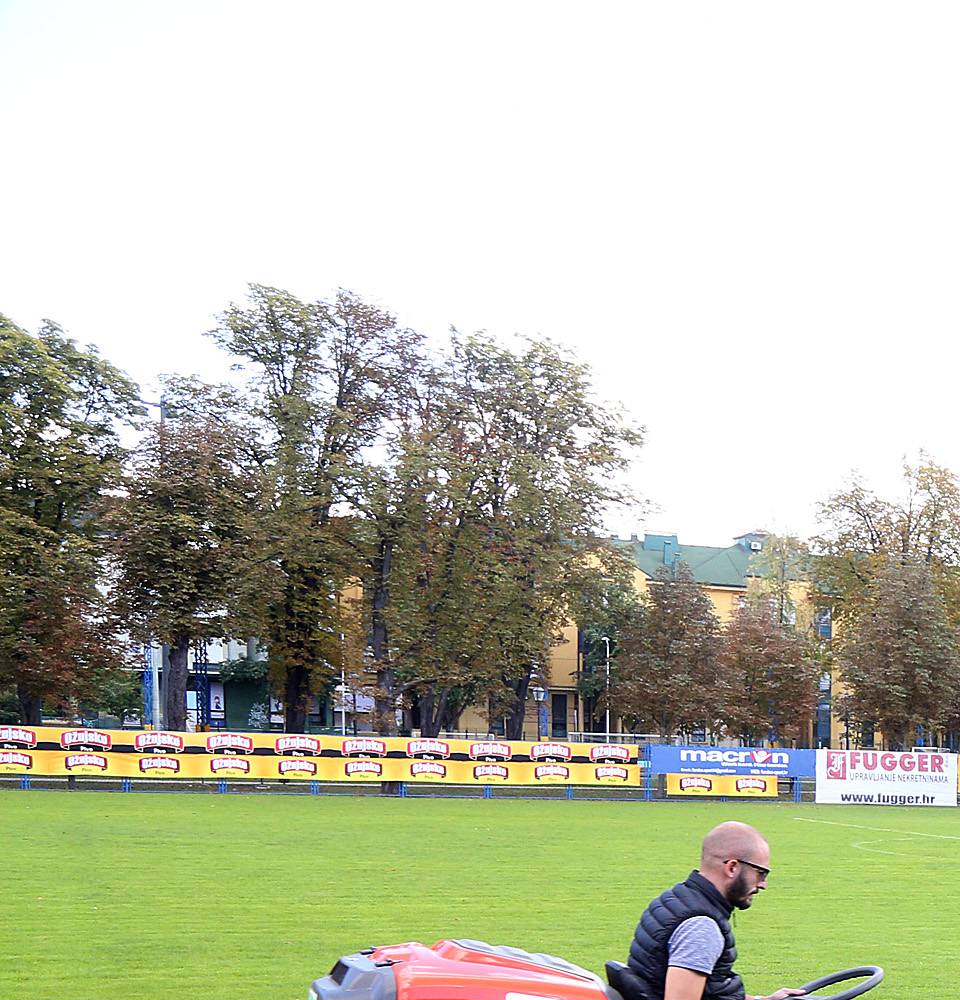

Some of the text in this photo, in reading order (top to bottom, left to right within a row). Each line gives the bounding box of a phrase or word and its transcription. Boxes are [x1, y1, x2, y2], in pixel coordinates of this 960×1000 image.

[64, 730, 107, 745] Ožujsko
[139, 733, 180, 747] Ožujsko
[210, 734, 250, 748] Ožujsko
[67, 754, 105, 767] Ožujsko
[849, 752, 944, 773] FUGGER
[849, 772, 949, 784] UPRAVLJANJE NEKRETNINAMA
[841, 793, 935, 805] www.fugger.hr
